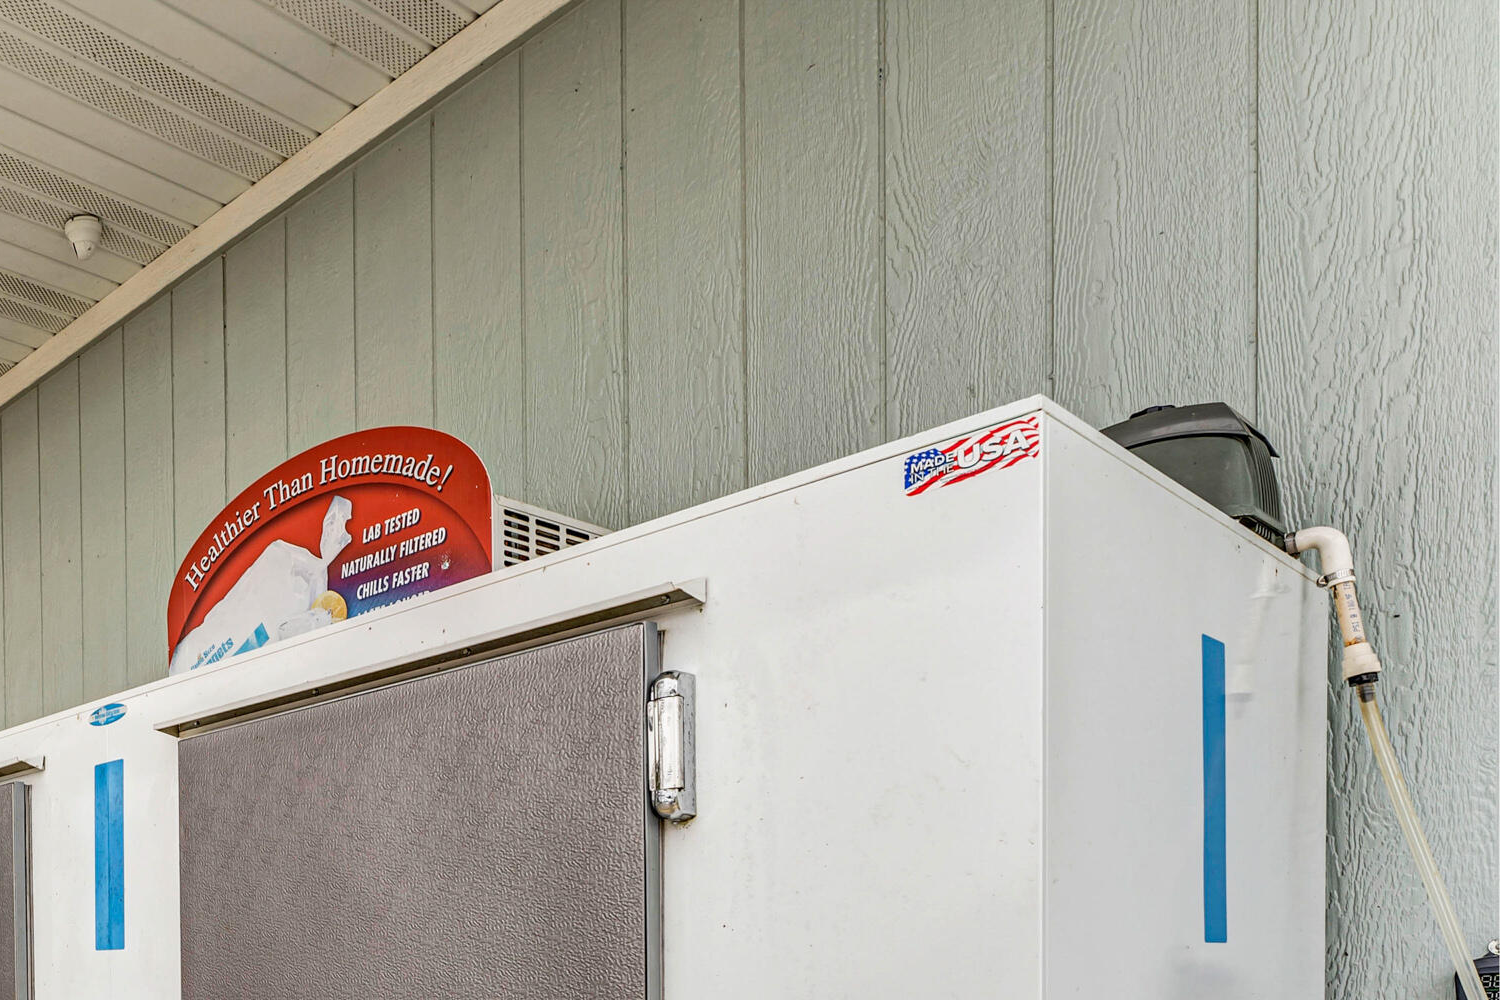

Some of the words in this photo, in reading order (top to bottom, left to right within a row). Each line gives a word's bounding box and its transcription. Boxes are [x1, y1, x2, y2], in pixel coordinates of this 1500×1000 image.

[910, 452, 954, 473] MADE
[957, 428, 1030, 469] USA
[909, 471, 925, 484] IN
[928, 463, 955, 479] THE
[185, 501, 261, 592] Healthier
[263, 473, 313, 511] Than
[319, 453, 454, 492] Homemade!
[362, 523, 382, 545] LAB
[384, 508, 420, 535] TESTED
[341, 547, 397, 579] NATURALLY
[399, 527, 446, 555] FILTERED
[356, 578, 390, 600] CHILLS
[392, 562, 430, 589] FASTER
